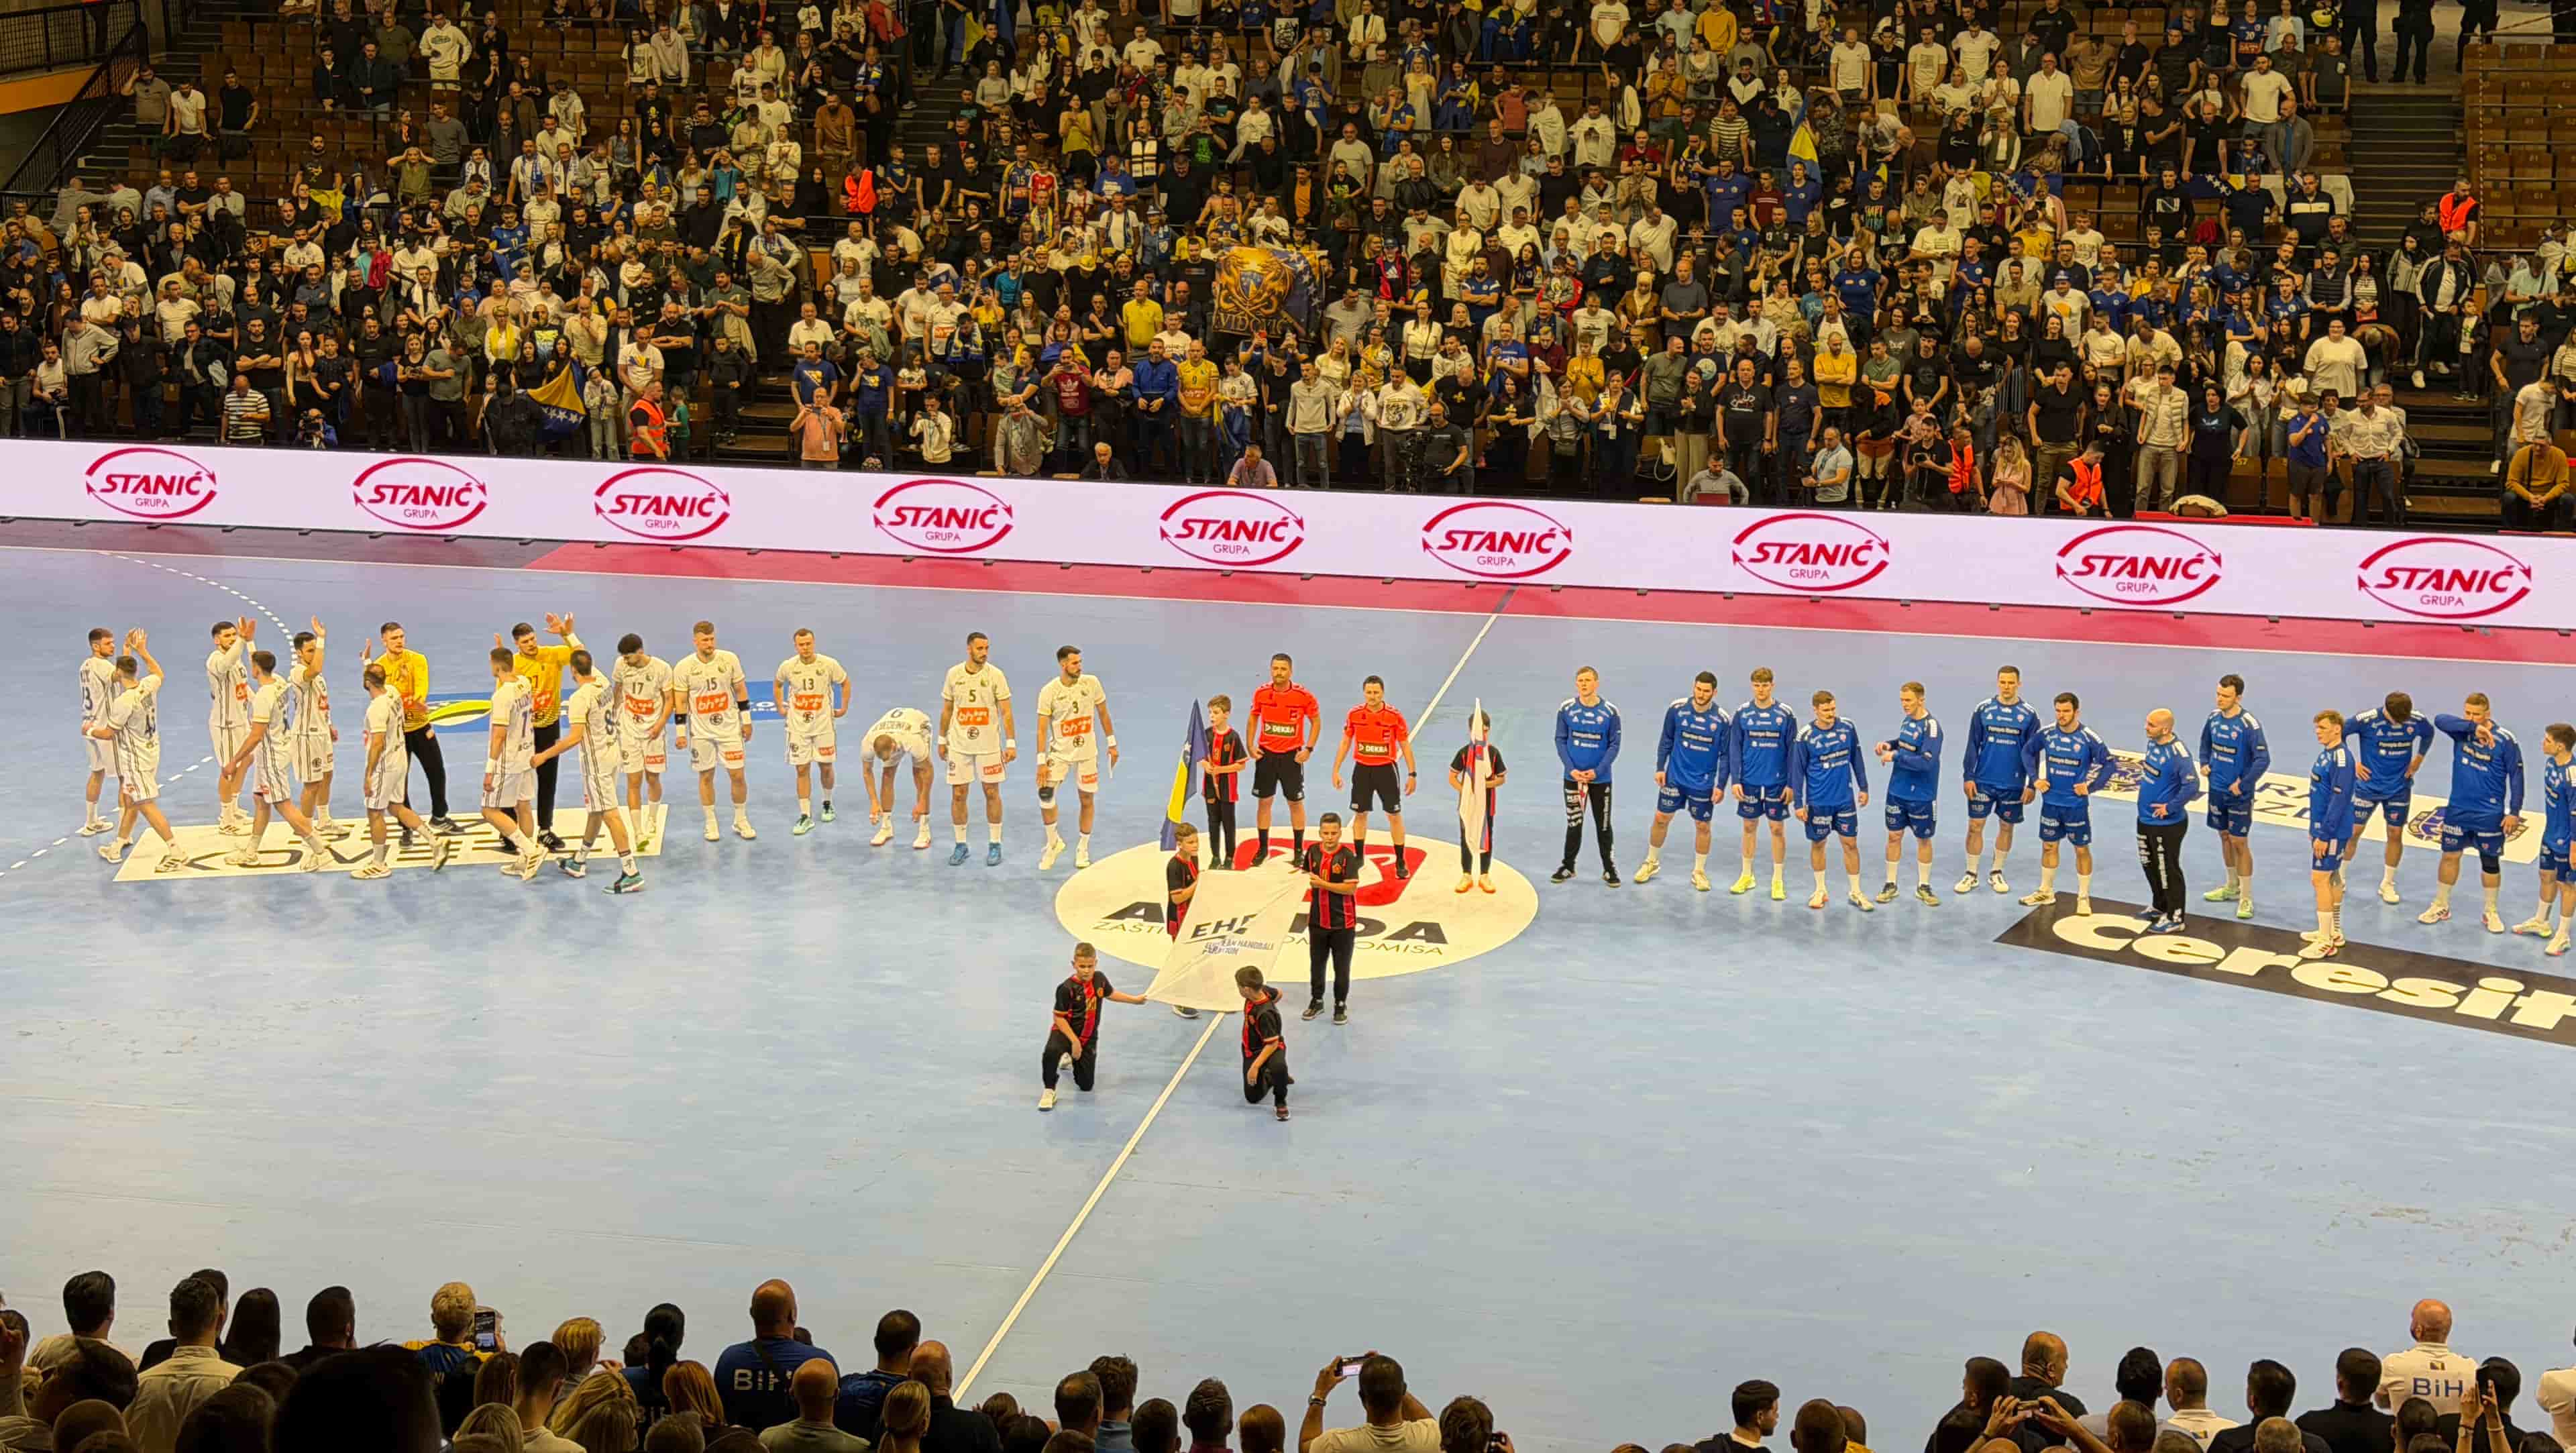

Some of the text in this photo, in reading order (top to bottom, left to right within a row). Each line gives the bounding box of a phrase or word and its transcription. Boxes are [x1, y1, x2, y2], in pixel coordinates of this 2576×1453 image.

[97, 471, 203, 496] STANIĆ
[367, 482, 472, 508] STANIĆ
[135, 498, 169, 508] GRUPA
[607, 492, 716, 518] STANIĆ
[404, 508, 437, 519] GRUPA
[886, 504, 999, 531] STANIĆ
[645, 519, 680, 529] GRUPA
[1173, 516, 1290, 543] STANIĆ
[925, 531, 961, 542] GRUPA
[1436, 527, 1556, 554] STANIĆ
[1213, 544, 1250, 555] GRUPA
[1747, 539, 1875, 568] STANIĆ
[1477, 555, 1515, 567] GRUPA
[2072, 552, 2206, 580] STANIĆ
[1789, 568, 1829, 580] GRUPA
[2373, 564, 2516, 594] STANIĆ
[2116, 582, 2158, 594] GRUPA
[2420, 594, 2464, 607] GRUPA
[632, 682, 644, 695] 17
[706, 677, 717, 691] 15
[802, 678, 814, 690] 13
[969, 690, 976, 702] 5
[1073, 701, 1079, 714] 3
[1272, 724, 1295, 733] DEKRA
[1364, 745, 1388, 753] DEKRA
[2052, 912, 2576, 1030] Ceresit
[2412, 1377, 2463, 1397] BiH
